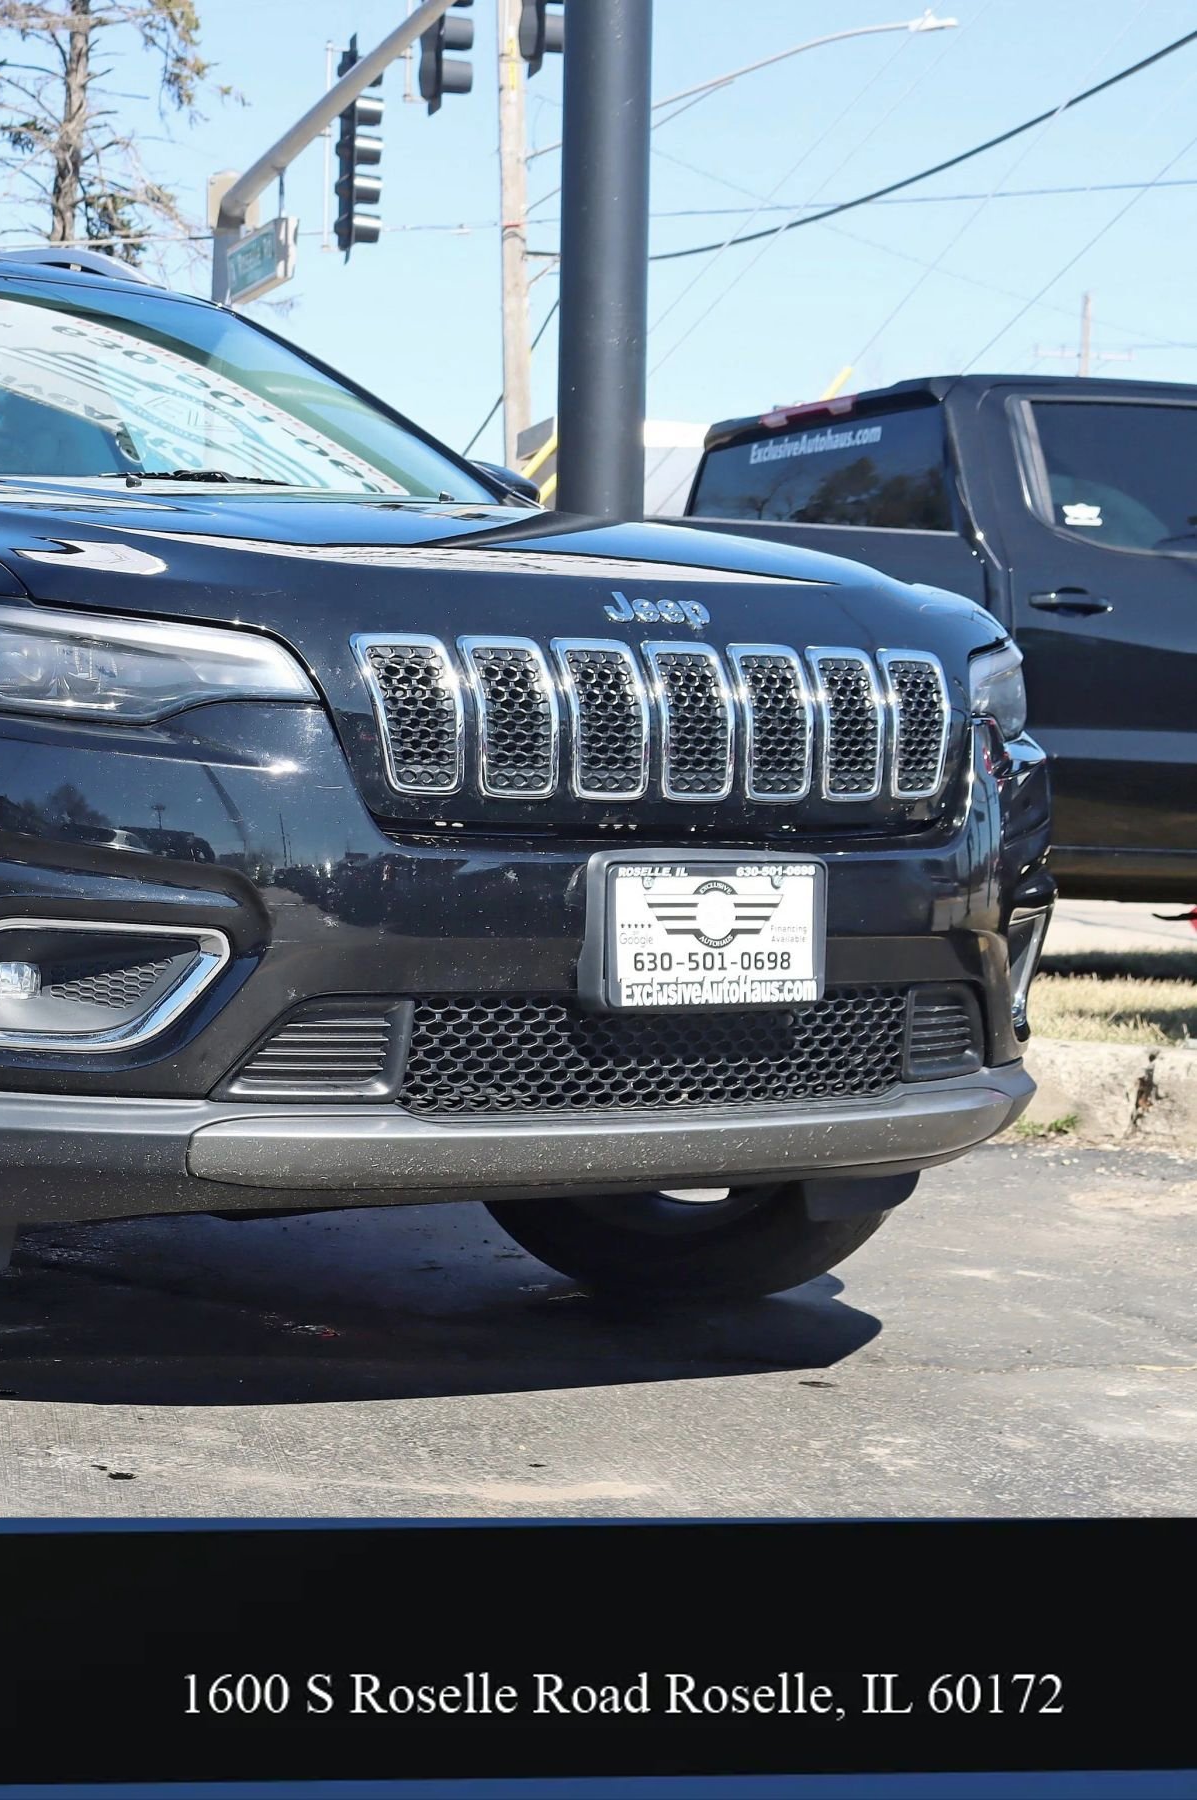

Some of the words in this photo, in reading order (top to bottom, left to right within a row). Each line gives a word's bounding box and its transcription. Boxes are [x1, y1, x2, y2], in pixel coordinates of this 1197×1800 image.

[749, 425, 882, 464] ExclusiveAutohaus.com
[603, 591, 711, 631] Jeep
[675, 867, 688, 877] IL
[735, 865, 816, 877] 630-501-0698
[699, 882, 733, 895] EXCLUSIVE
[770, 924, 808, 936] Financing
[619, 932, 654, 948] Google
[699, 934, 734, 947] AUTOHAUS
[770, 935, 807, 944] Available
[633, 951, 792, 972] 630-501-0698
[620, 976, 817, 1007] ExclusiveAutoHaus.com
